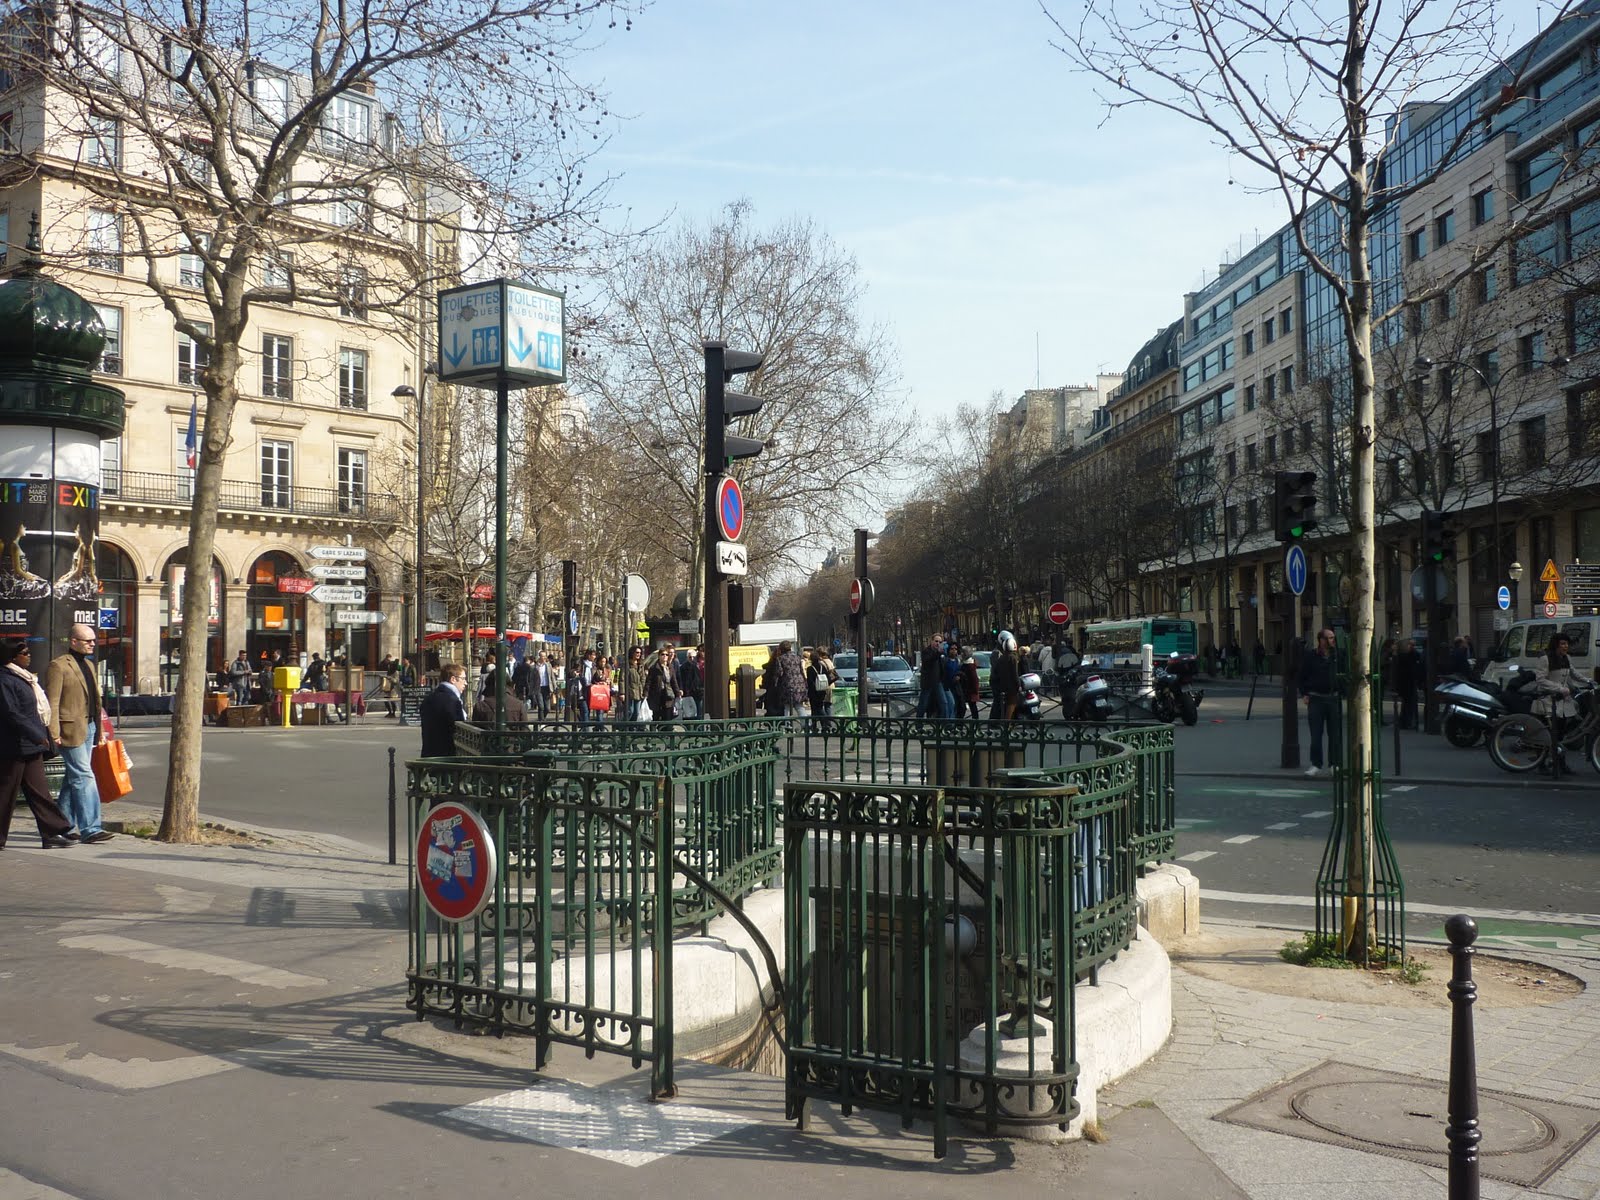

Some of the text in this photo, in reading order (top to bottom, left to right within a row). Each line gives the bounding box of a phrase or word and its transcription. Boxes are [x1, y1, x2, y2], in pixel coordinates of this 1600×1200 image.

[444, 291, 499, 312] TOILETTES
[508, 290, 560, 312] TOILETTES
[444, 307, 499, 322] PUBQUES
[508, 306, 560, 322] PUBLIQUES
[0, 482, 26, 502] IT
[59, 484, 97, 509] EXIT
[74, 610, 95, 623] mac
